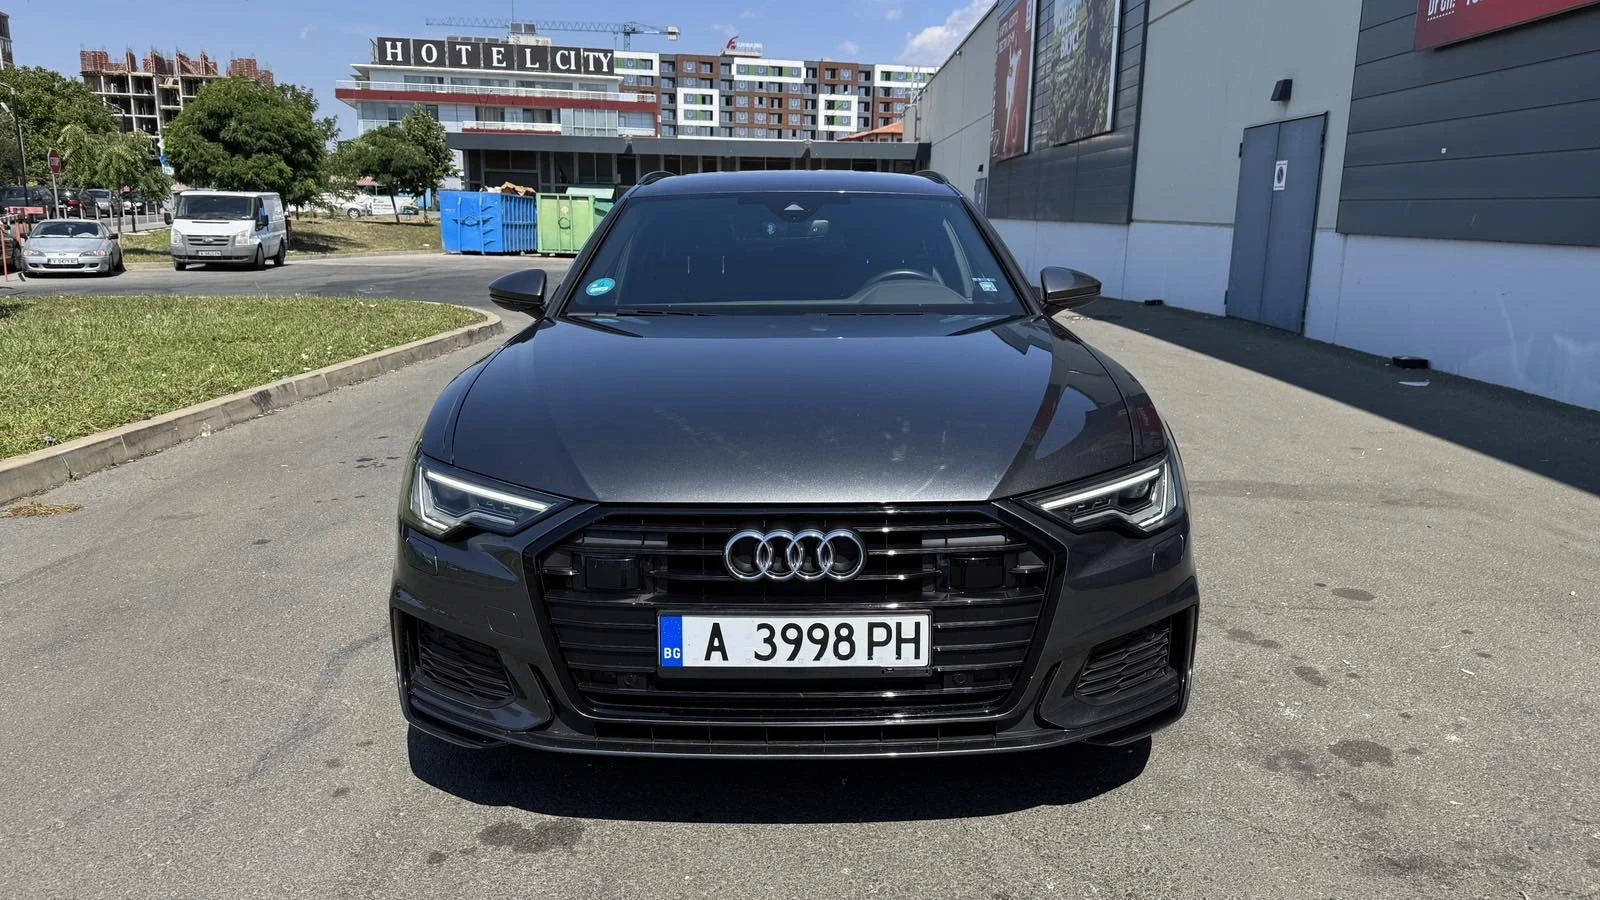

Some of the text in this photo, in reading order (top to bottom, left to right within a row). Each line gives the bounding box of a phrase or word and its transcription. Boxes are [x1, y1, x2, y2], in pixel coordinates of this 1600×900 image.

[384, 40, 613, 72] HOTEL CITY
[664, 647, 681, 659] BG
[705, 621, 921, 661] A 3998 PH
